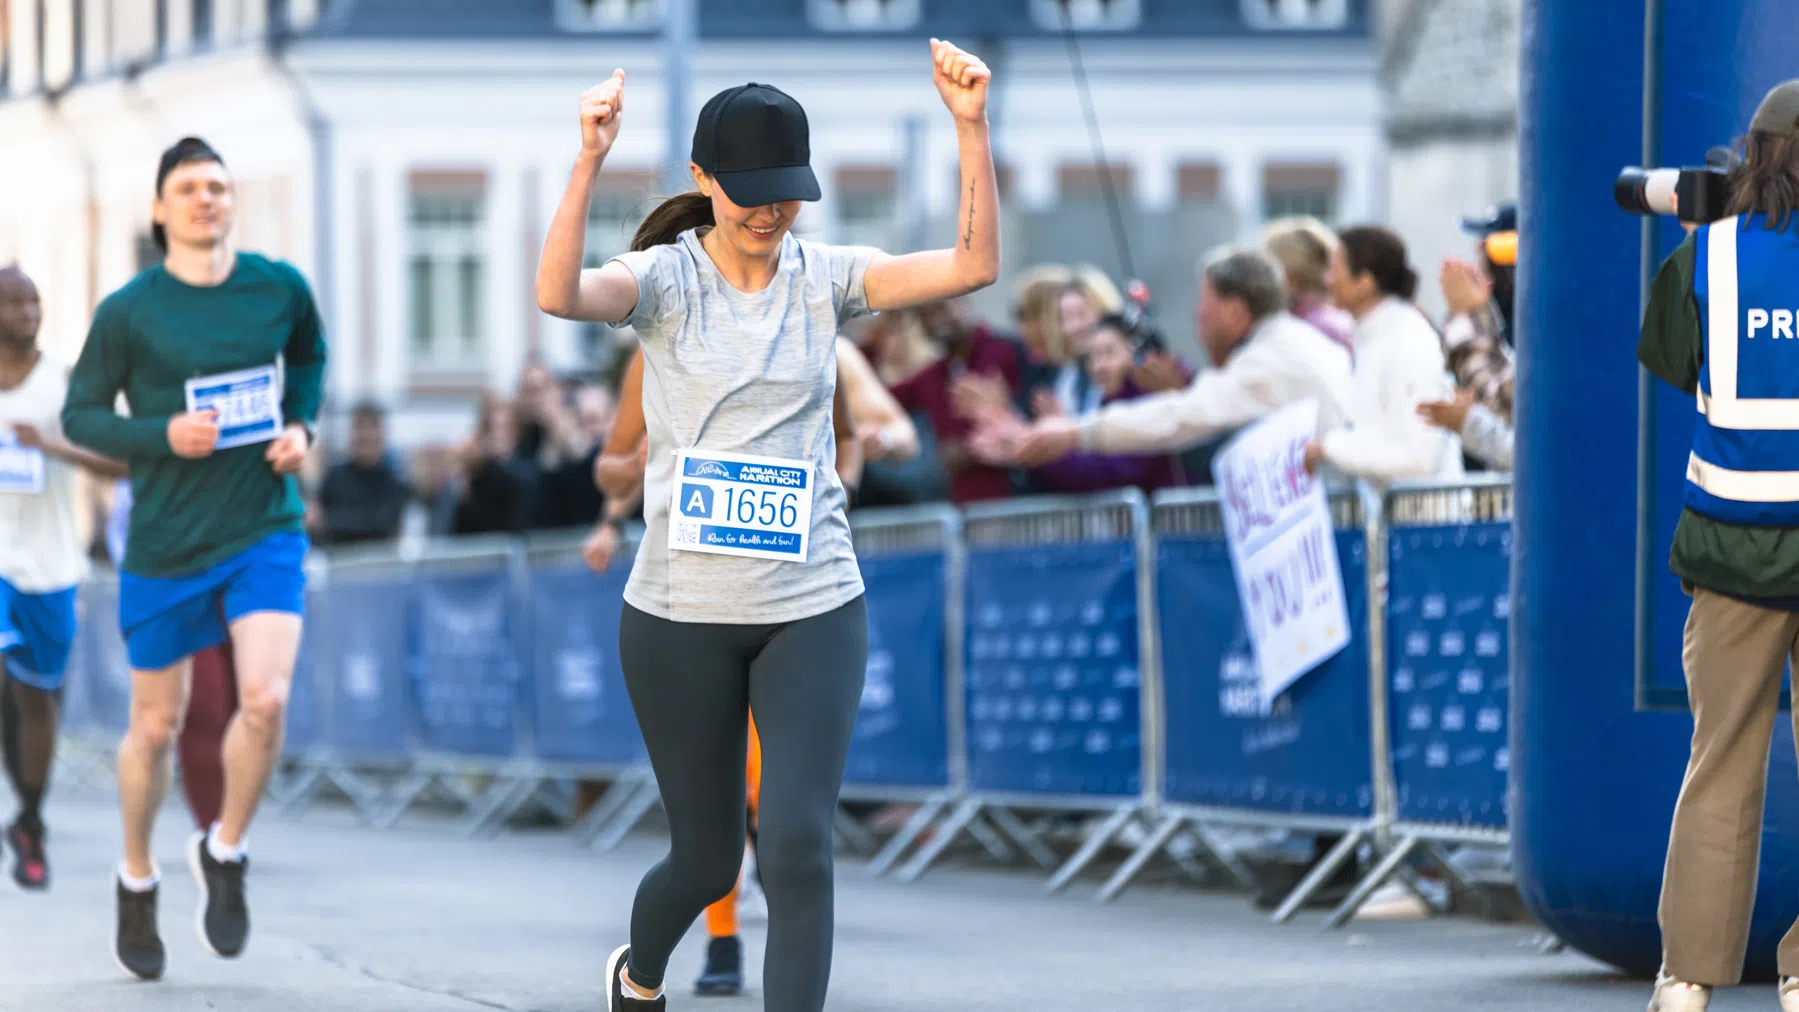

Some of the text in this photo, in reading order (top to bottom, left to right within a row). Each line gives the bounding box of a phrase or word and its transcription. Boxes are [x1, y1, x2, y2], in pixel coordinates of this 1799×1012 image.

[1747, 308, 1799, 339] PR
[740, 472, 801, 486] MARATHON
[741, 465, 801, 479] ANNUAL CITY
[686, 489, 706, 514] A
[724, 487, 798, 528] 1656
[707, 532, 725, 544] Run
[726, 533, 737, 544] for
[739, 534, 761, 545] health
[763, 535, 777, 545] and
